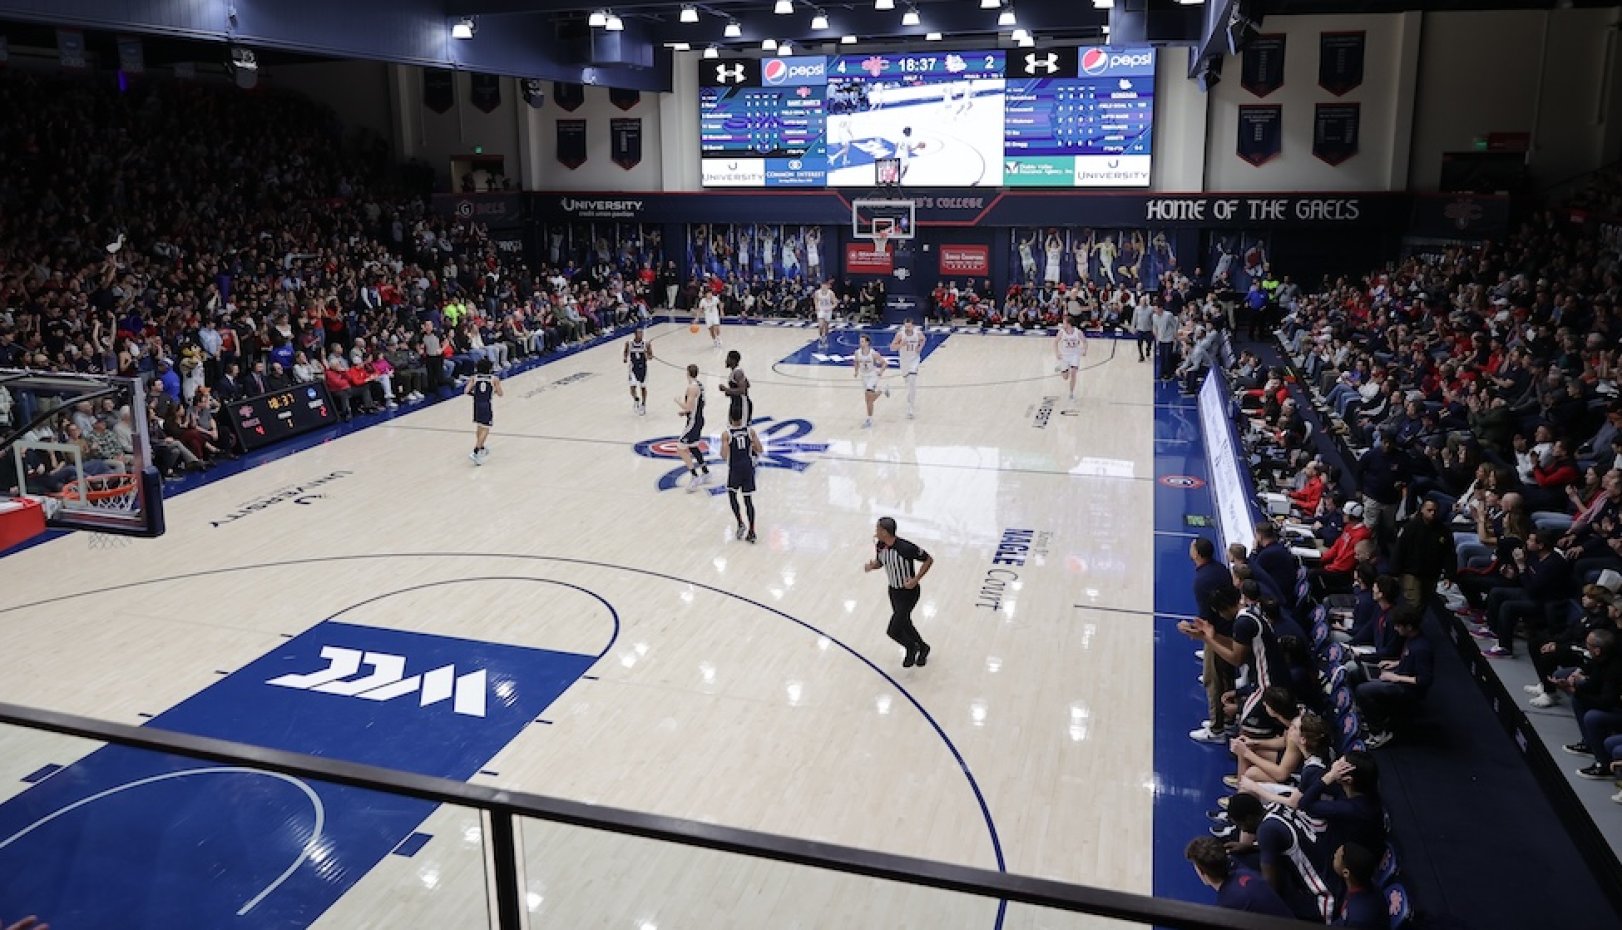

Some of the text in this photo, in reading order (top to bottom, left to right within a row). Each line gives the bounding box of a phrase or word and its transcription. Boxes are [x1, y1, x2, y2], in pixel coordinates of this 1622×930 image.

[836, 60, 847, 74] 4
[898, 57, 937, 72] 18:37
[984, 55, 995, 69] 2
[1110, 52, 1152, 69] pepsi
[788, 62, 825, 79] pepsi
[702, 173, 763, 182] UNIVERSITY
[1077, 171, 1149, 180] UNIVERSITY
[560, 197, 644, 212] UNIVERSITY
[936, 198, 984, 209] COLLEGE
[1146, 199, 1360, 221] HOME OF THE GAELS
[208, 470, 354, 528] UNIVERSITY
[975, 569, 1019, 612] Court
